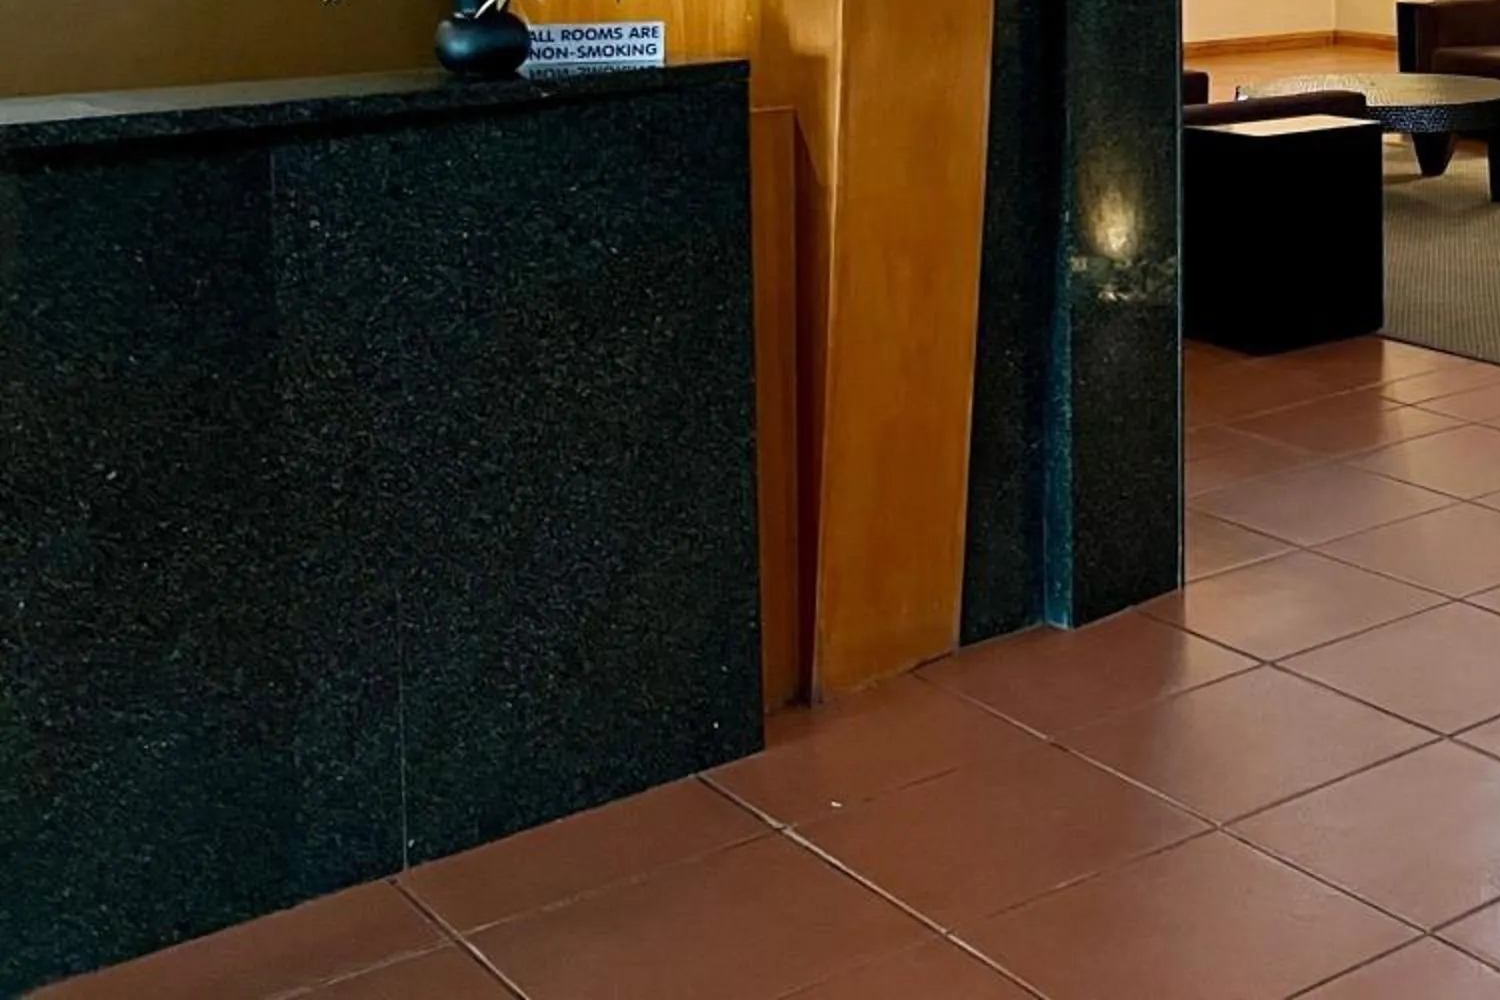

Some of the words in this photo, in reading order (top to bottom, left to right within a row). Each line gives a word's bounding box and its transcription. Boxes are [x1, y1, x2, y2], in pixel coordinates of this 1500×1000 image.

[529, 29, 554, 42] ALL
[561, 27, 622, 41] ROOMS
[629, 25, 659, 39] ARE
[529, 43, 657, 60] NON-SMOKING
